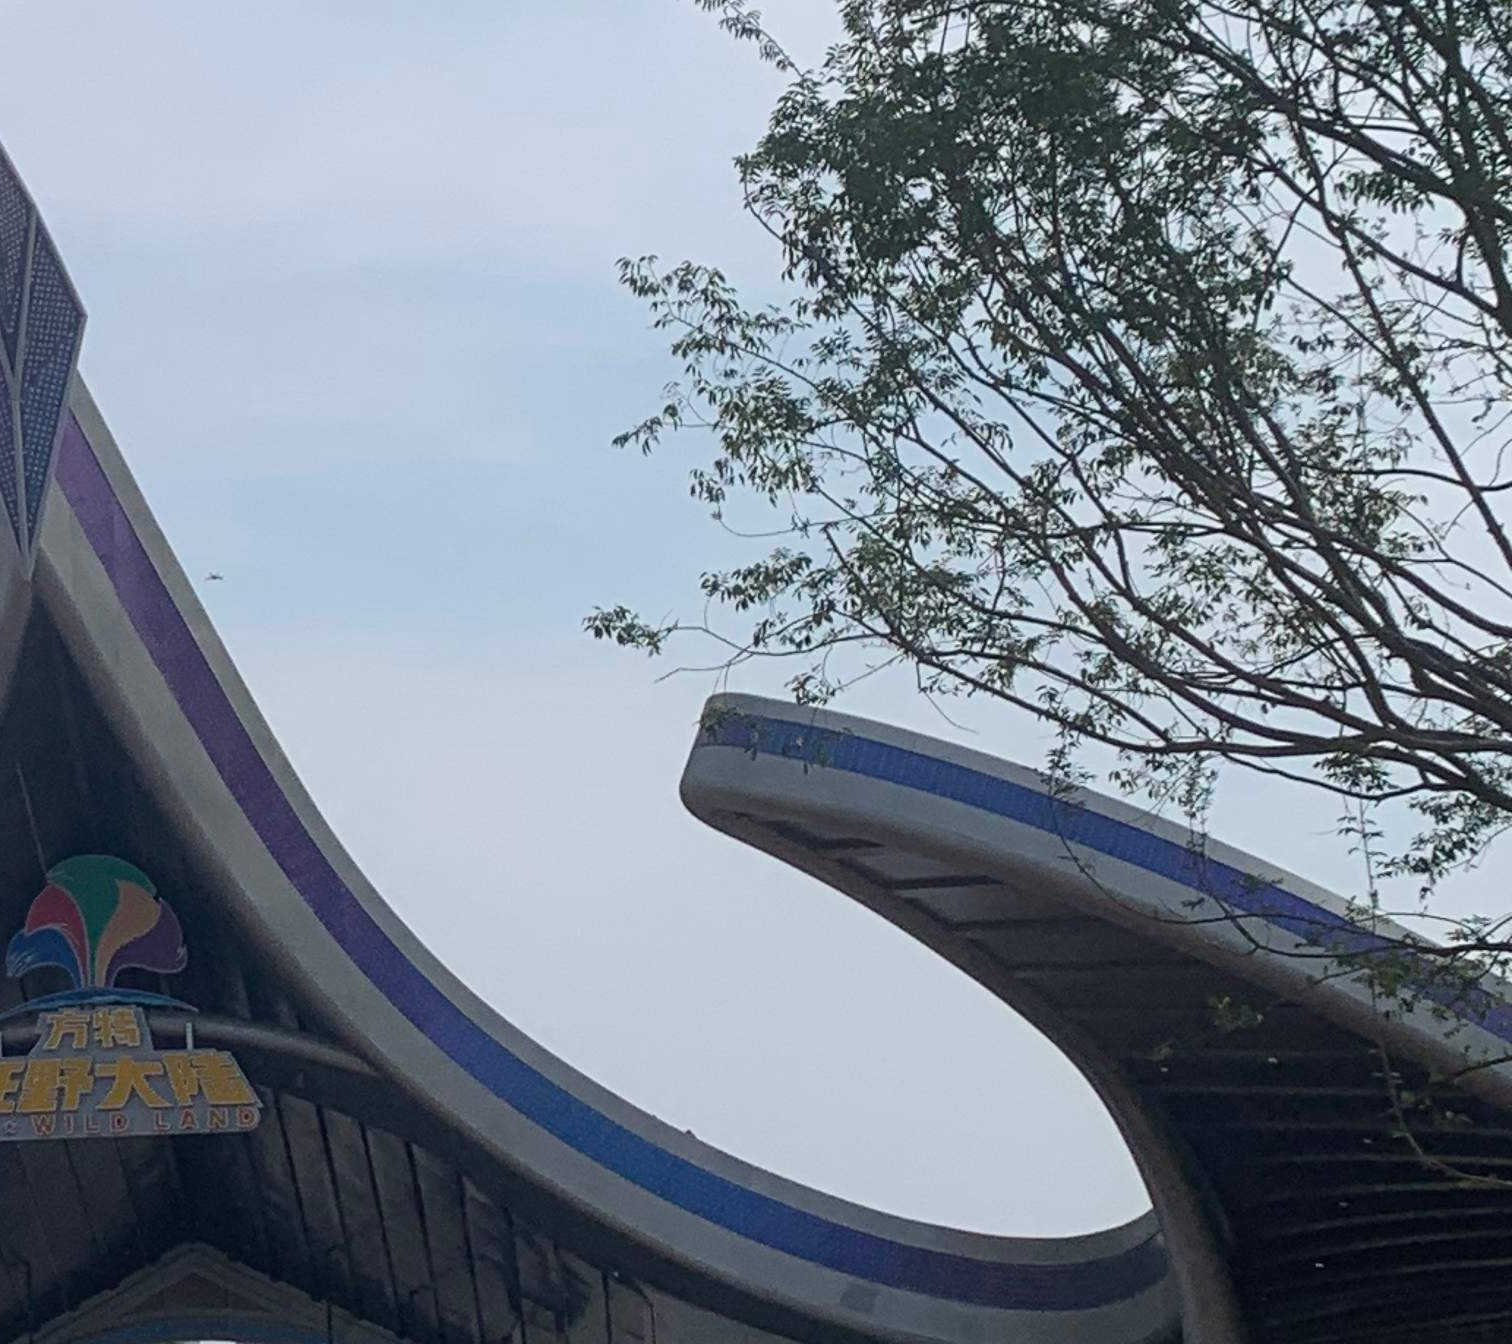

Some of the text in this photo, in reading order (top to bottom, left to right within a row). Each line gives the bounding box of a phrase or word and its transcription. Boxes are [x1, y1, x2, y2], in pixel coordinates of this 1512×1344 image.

[46, 1009, 140, 1049] 方特
[31, 1112, 129, 1134] WILD
[154, 1107, 260, 1131] LAND
